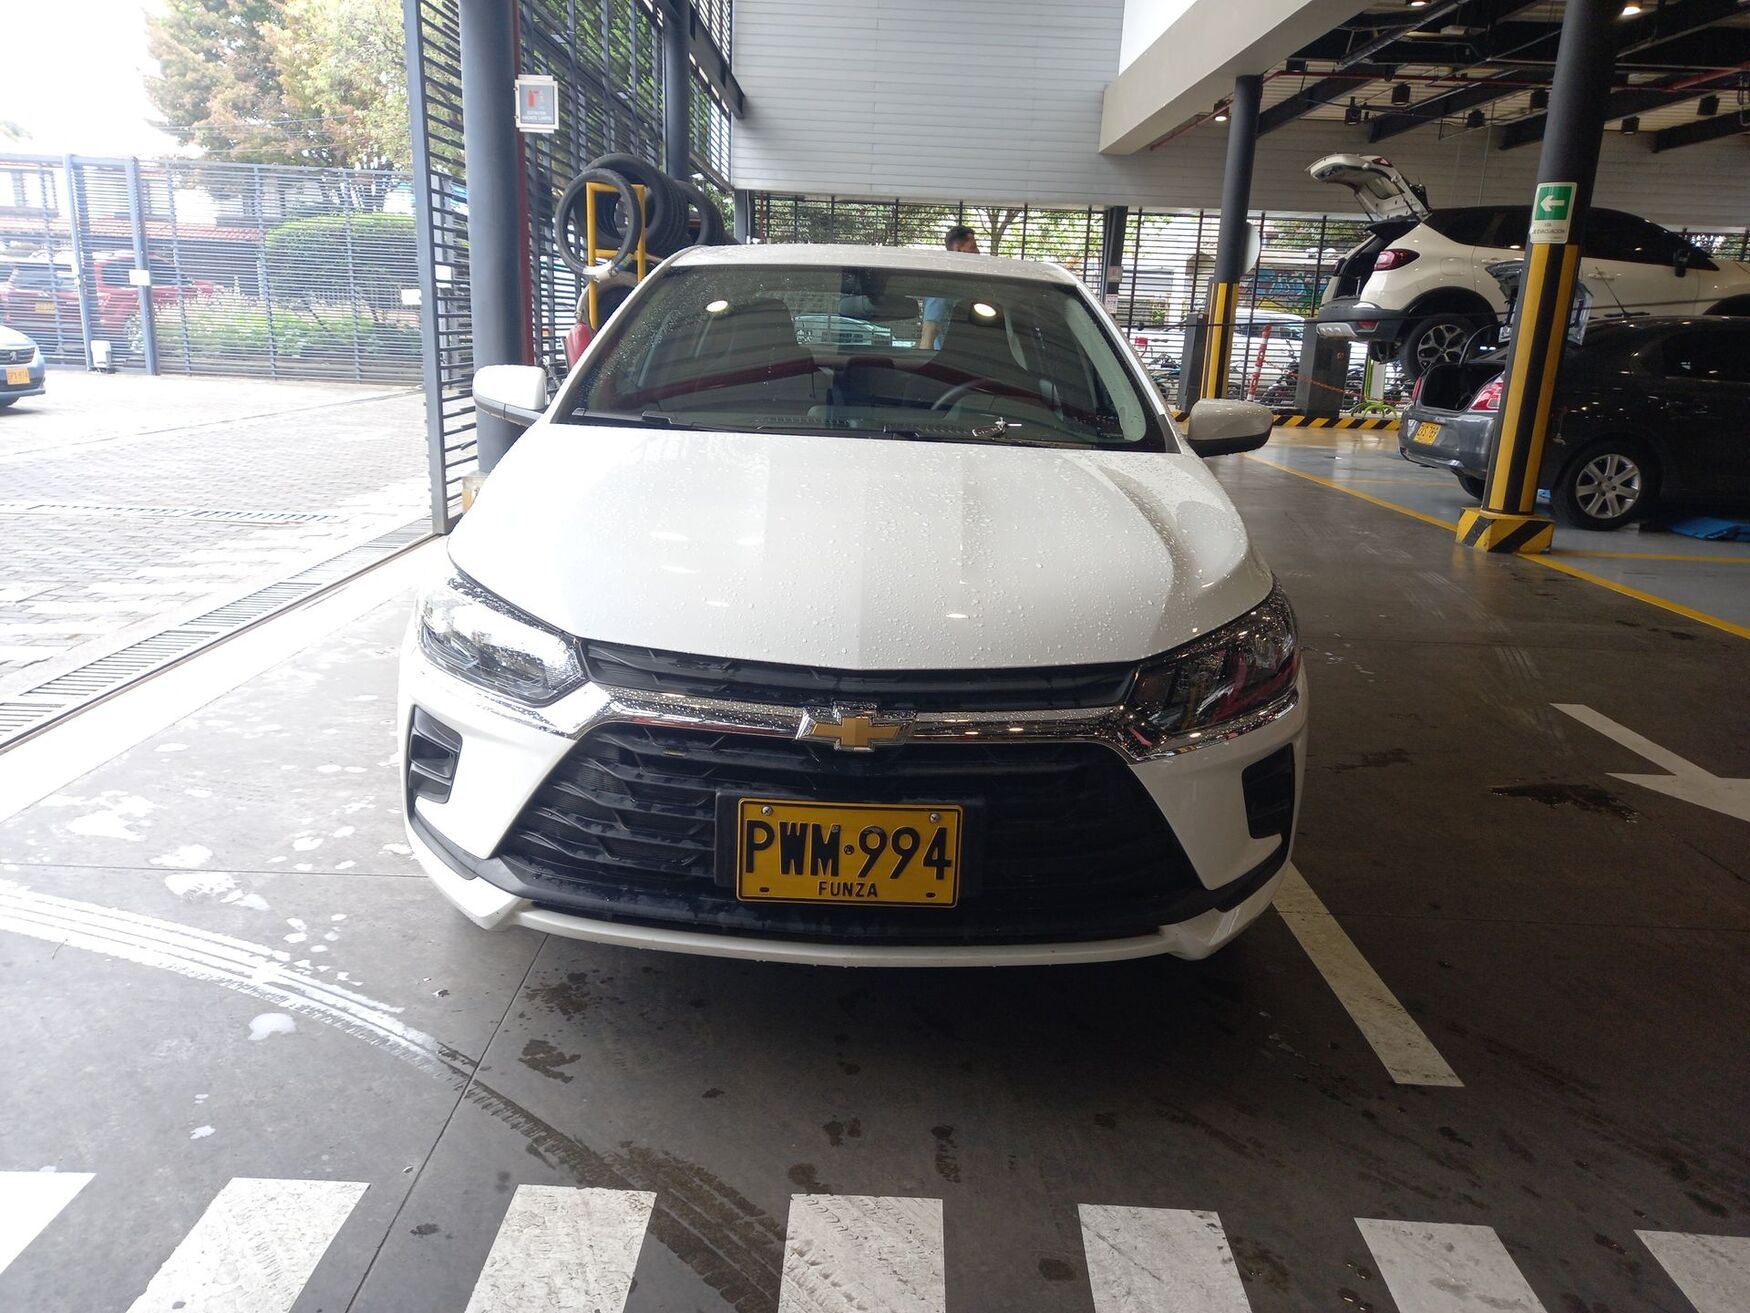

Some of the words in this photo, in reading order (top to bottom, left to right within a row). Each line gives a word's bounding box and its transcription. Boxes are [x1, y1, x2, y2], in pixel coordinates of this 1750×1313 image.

[745, 819, 841, 877] PWM
[858, 825, 952, 881] 994
[818, 881, 878, 898] FUNZA
